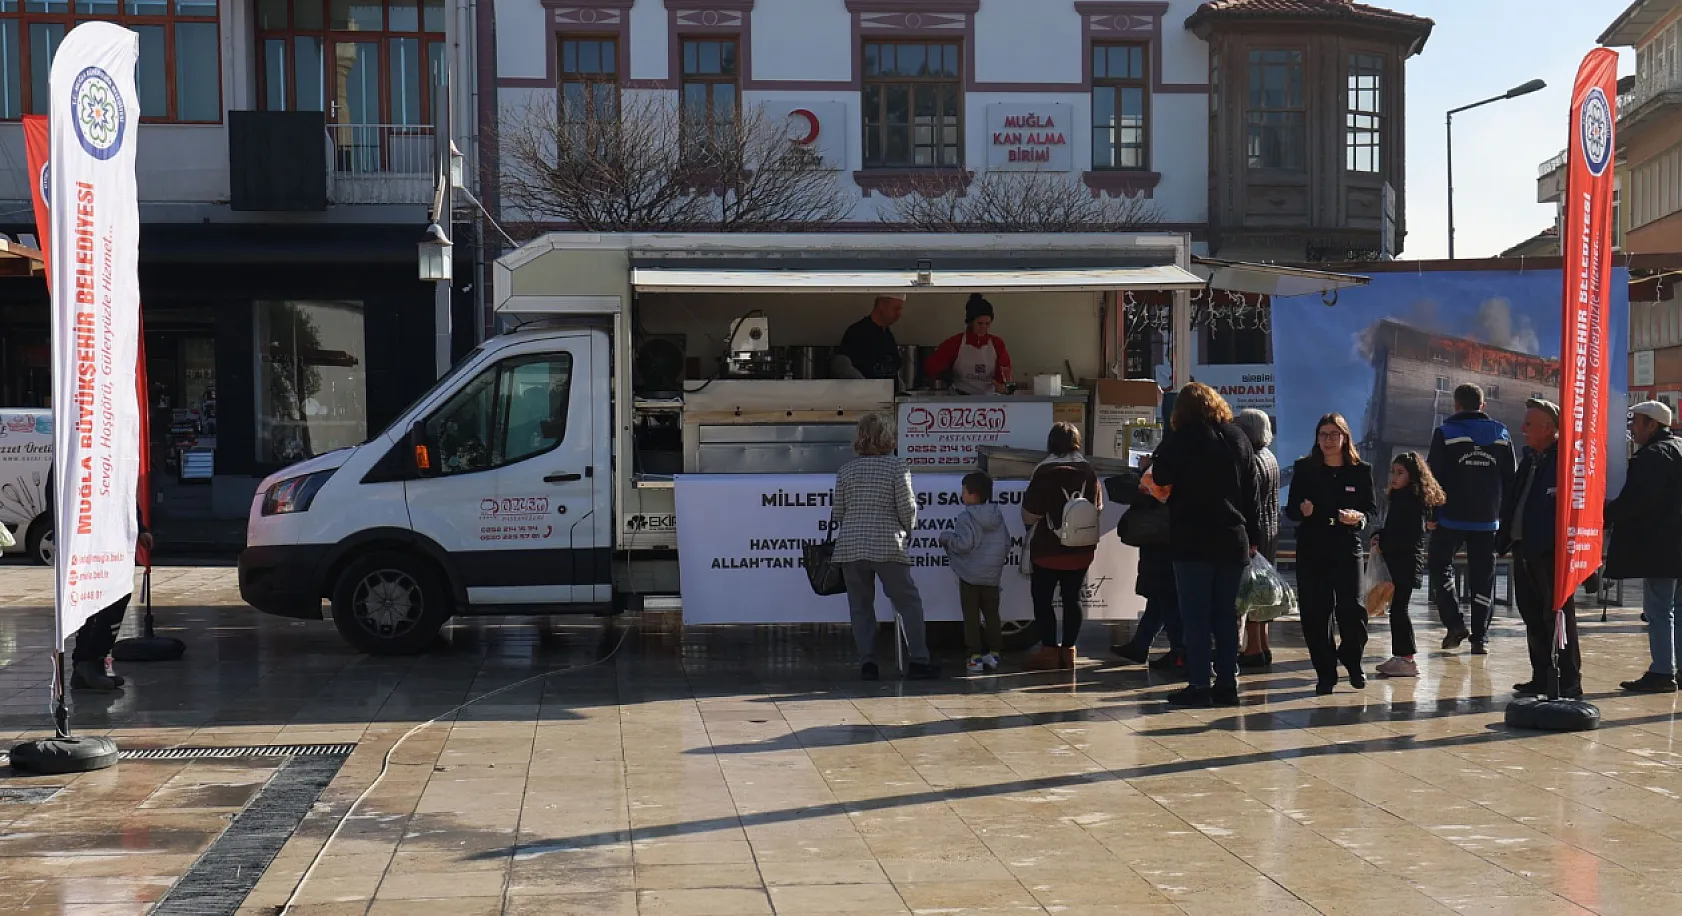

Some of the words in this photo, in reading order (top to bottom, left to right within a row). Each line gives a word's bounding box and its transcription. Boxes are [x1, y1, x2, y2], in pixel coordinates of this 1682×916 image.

[1004, 112, 1054, 128] MUĞLA
[993, 132, 1022, 145] KAN
[1026, 132, 1066, 145] ALMA
[1008, 147, 1050, 162] BİRİMİ
[75, 181, 95, 304] BELEDİYESİ
[101, 294, 115, 376] Güleryüzle
[1572, 439, 1586, 509] MUĞLA
[77, 457, 92, 534] MUĞLA
[762, 489, 833, 507] MİLLETİ
[917, 492, 932, 510] ŞI
[711, 557, 794, 569] ALLAH'TAN
